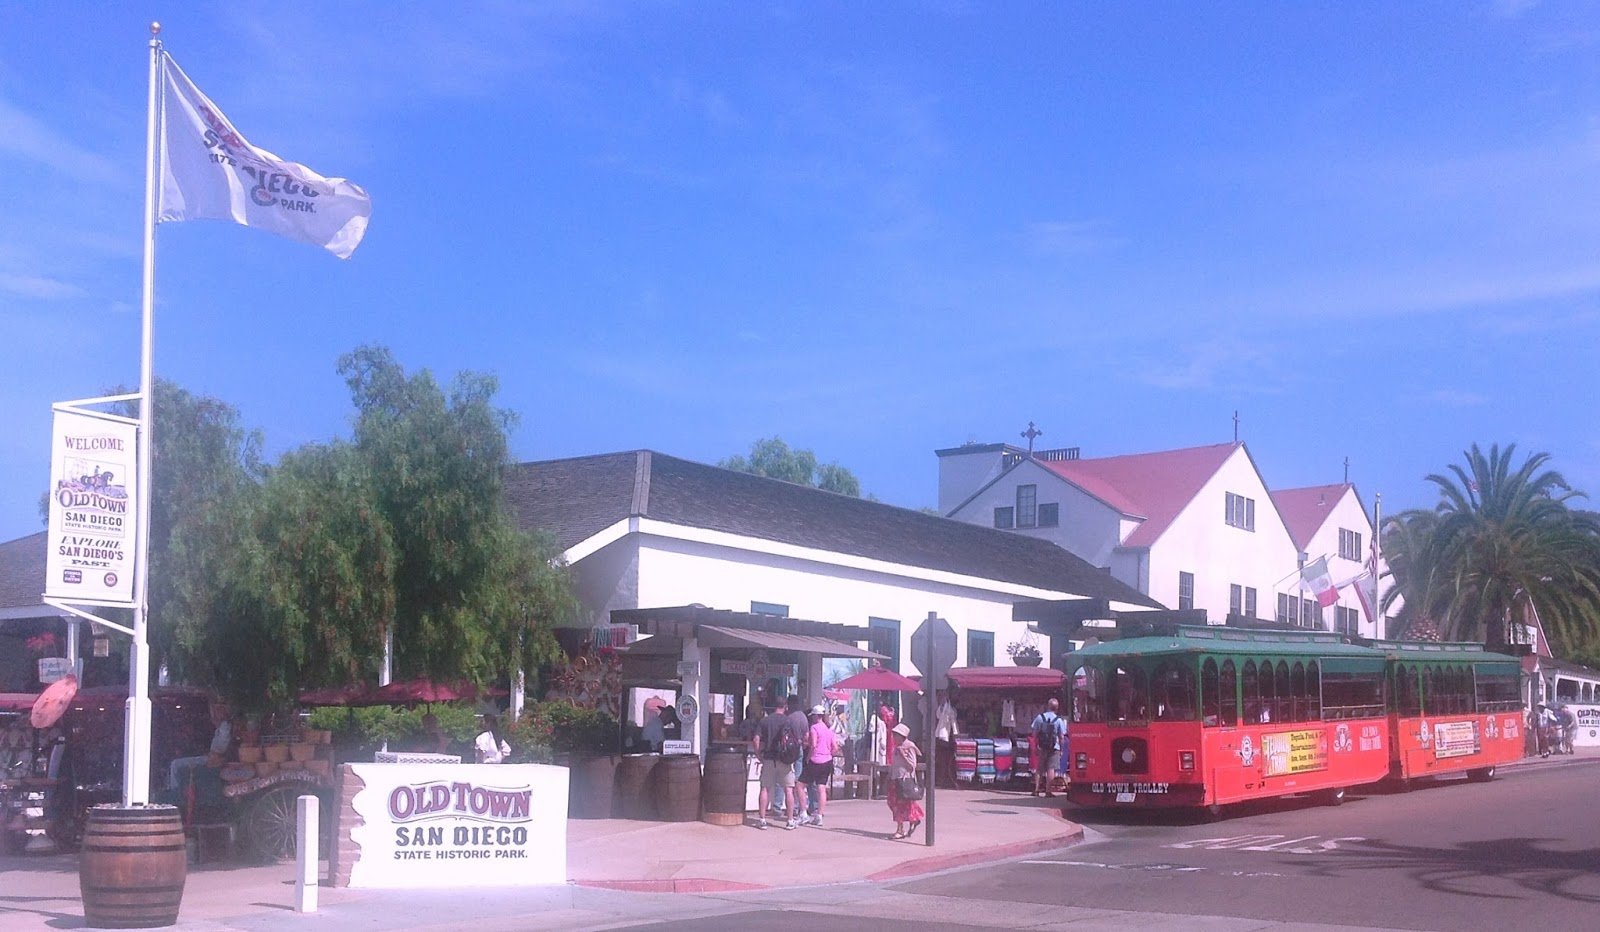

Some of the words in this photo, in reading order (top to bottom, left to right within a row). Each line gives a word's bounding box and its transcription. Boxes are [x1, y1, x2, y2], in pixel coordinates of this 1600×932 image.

[280, 198, 317, 214] PARK.
[64, 436, 125, 452] WELCOME
[60, 489, 90, 508] OLD
[90, 493, 127, 513] TOWN
[65, 512, 87, 523] SAN
[90, 514, 123, 527] DIEGO
[61, 536, 123, 550] EXPLORE
[59, 545, 81, 557] SAN
[83, 547, 124, 561] DIEGO'S
[72, 559, 111, 568] PAST
[1091, 783, 1105, 793] OLD
[1106, 783, 1130, 794] TOWN
[1132, 783, 1169, 794] TROLLEY
[389, 786, 450, 819] OLD
[451, 781, 532, 818] TOWN
[395, 826, 444, 846] SAN
[452, 826, 528, 846] DIEGO
[393, 851, 431, 860] STATE
[436, 850, 491, 860] HISTORIC
[495, 850, 528, 859] PARK.
